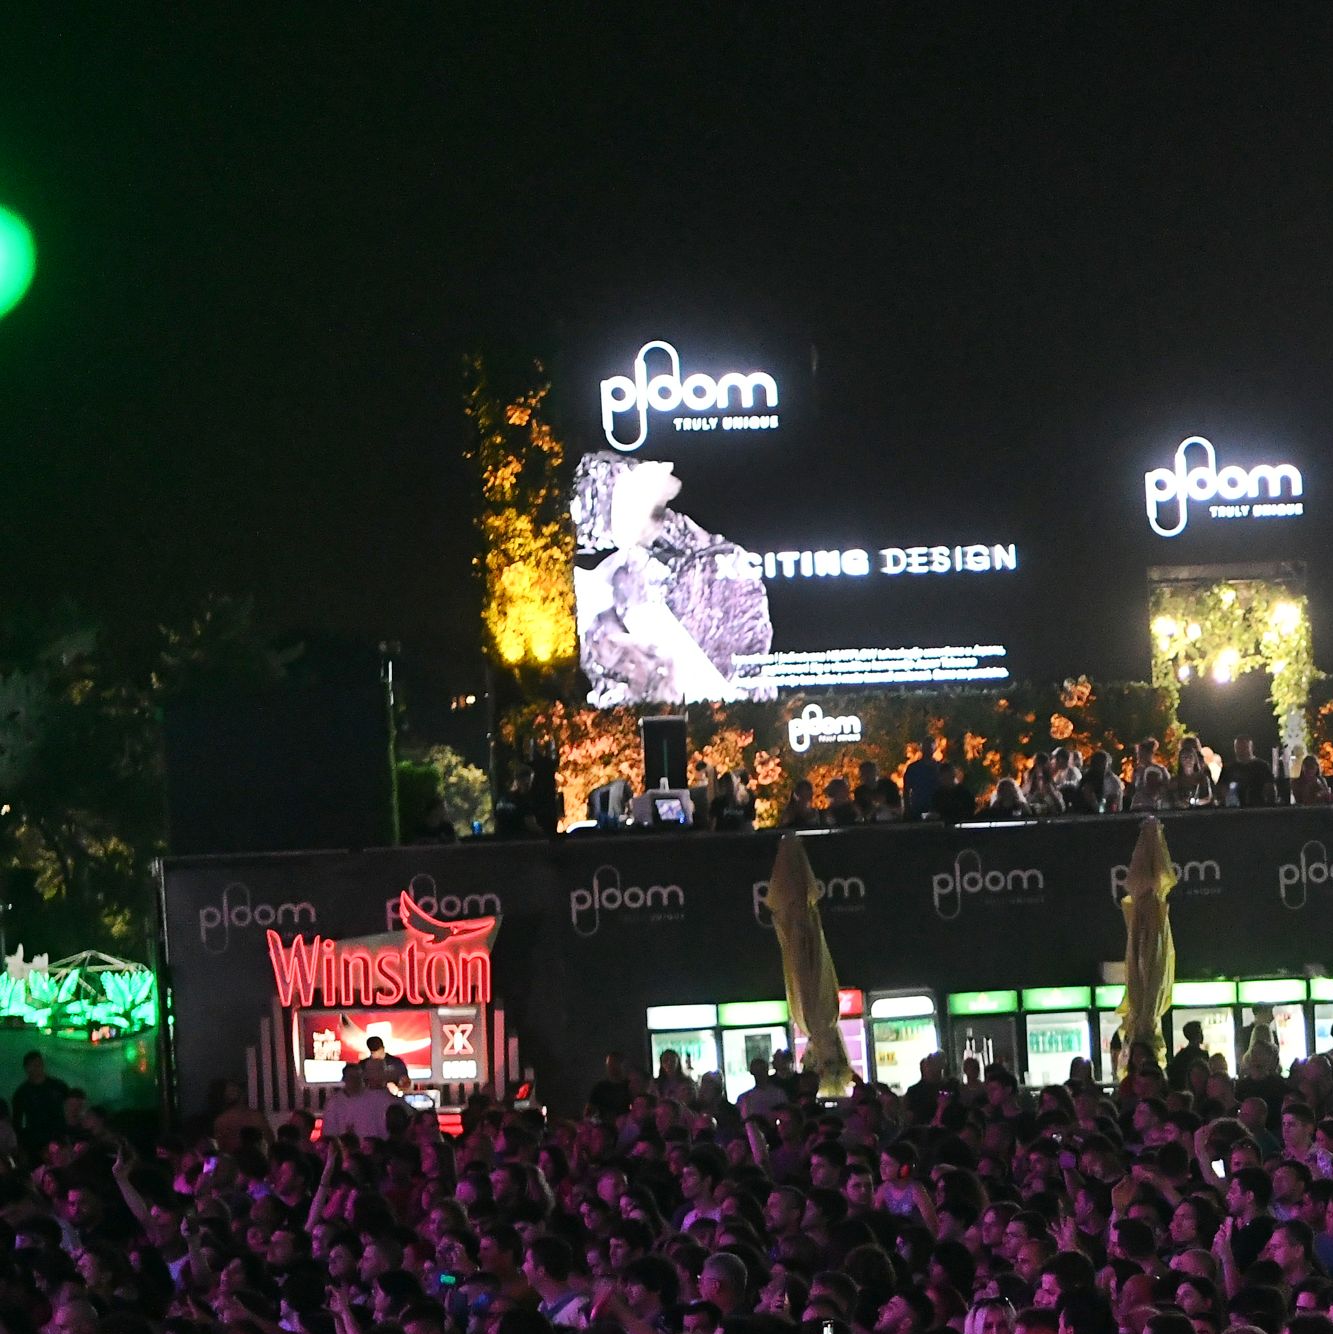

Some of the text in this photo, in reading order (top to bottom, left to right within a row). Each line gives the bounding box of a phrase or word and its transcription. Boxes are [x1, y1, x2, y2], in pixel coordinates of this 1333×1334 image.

[600, 340, 778, 452] ploom
[1145, 436, 1303, 538] ploom
[880, 544, 1017, 575] DESIGN
[570, 865, 685, 937] ploom
[932, 848, 1045, 919] ploom
[266, 928, 492, 1008] Winston
